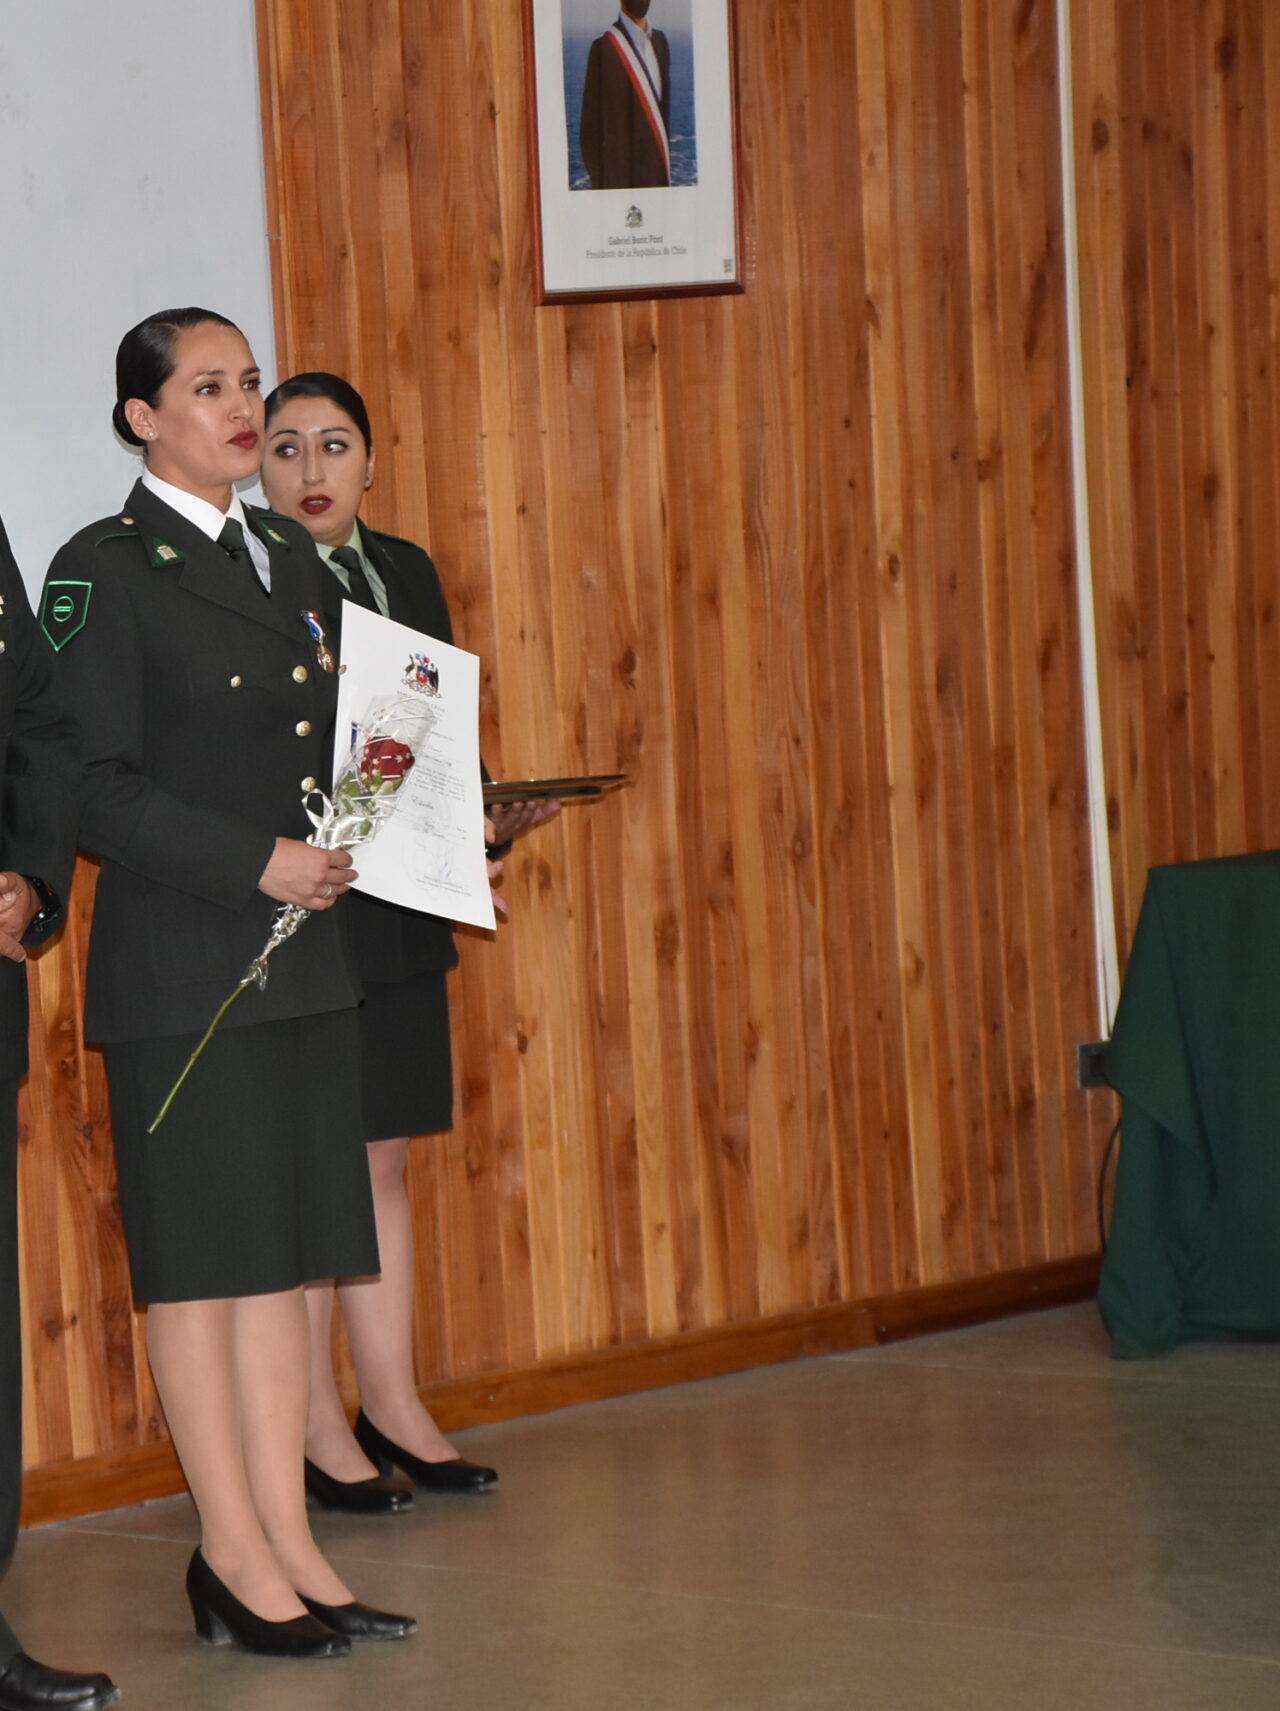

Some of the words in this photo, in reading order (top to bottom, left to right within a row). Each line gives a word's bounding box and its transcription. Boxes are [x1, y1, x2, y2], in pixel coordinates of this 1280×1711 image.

[608, 236, 631, 246] Gabriel
[632, 235, 648, 245] Boric
[586, 250, 616, 260] Presidente
[672, 246, 688, 255] Chile
